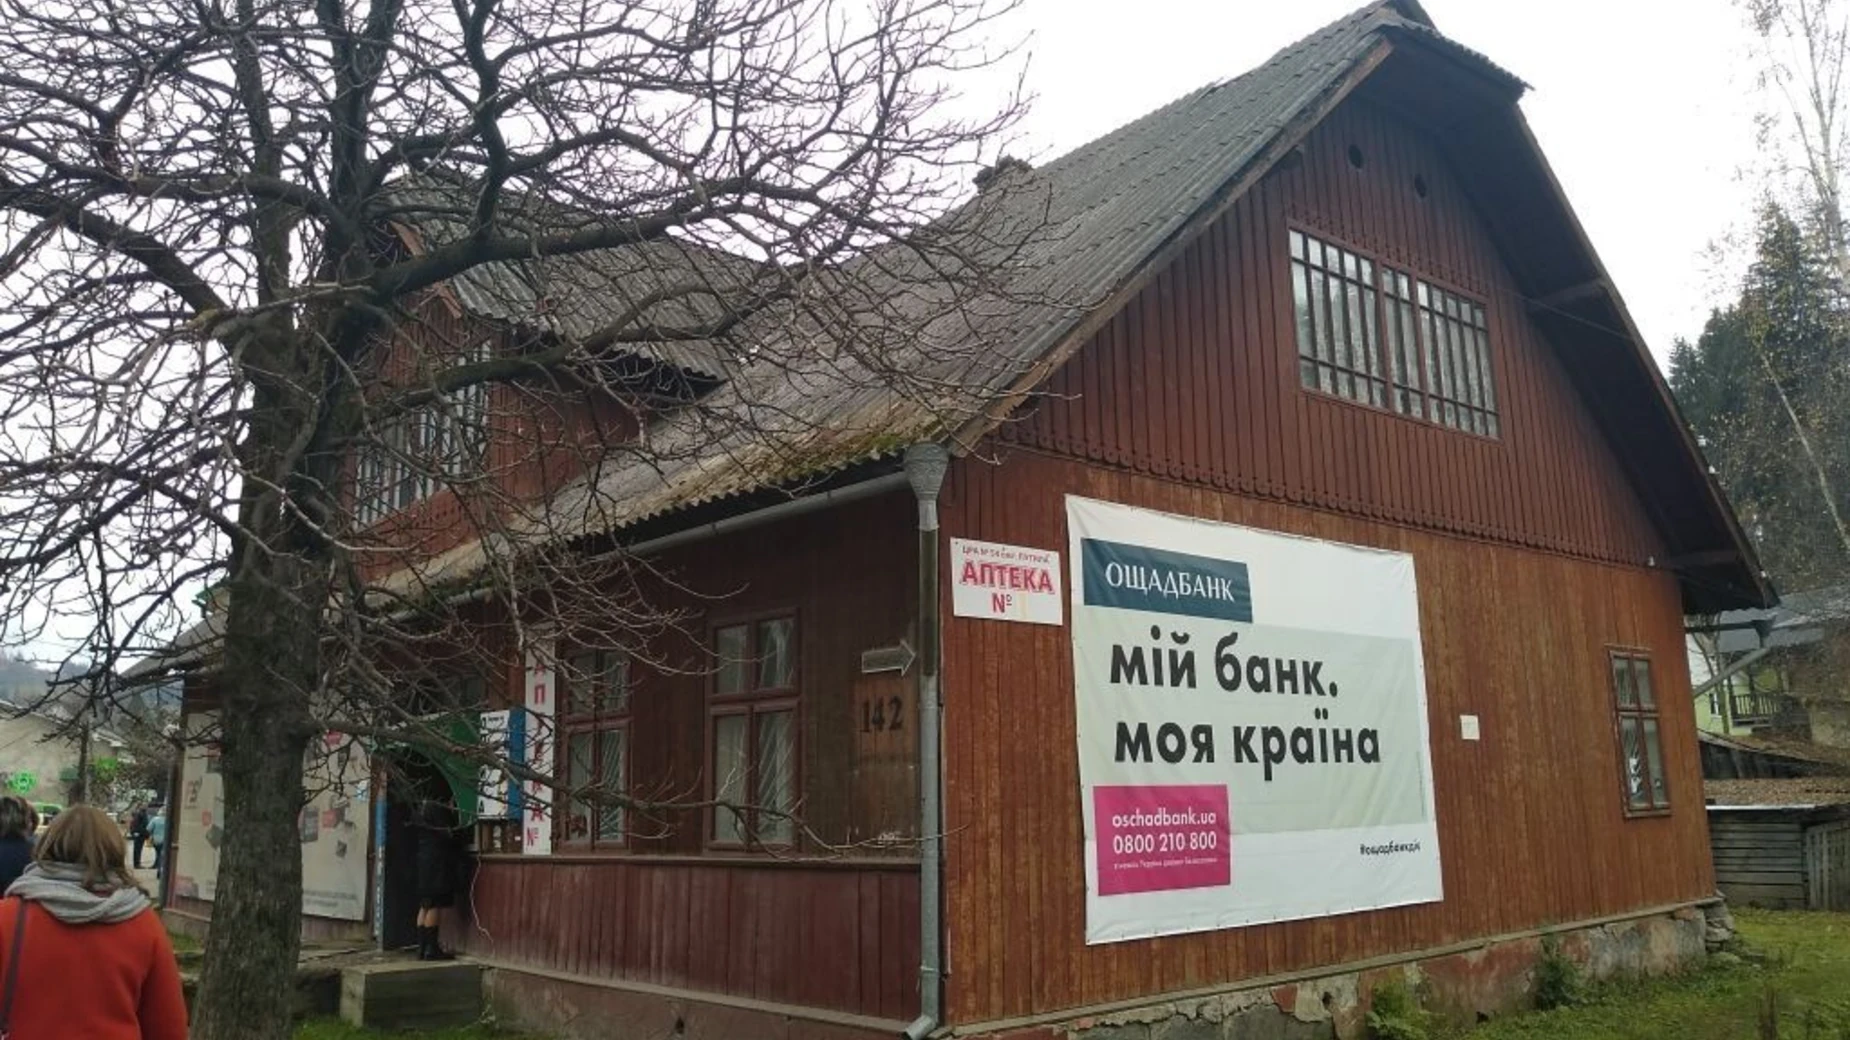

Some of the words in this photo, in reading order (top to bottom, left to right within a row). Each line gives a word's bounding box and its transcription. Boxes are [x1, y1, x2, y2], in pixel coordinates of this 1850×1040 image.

[962, 560, 1055, 594] АПТЕКА
[1105, 561, 1235, 602] ОЩАДБАНК
[1110, 624, 1197, 688] мій
[1215, 631, 1338, 698] банк.
[859, 695, 903, 733] 142
[1114, 721, 1215, 764] моя
[1232, 707, 1381, 782] країна
[1112, 806, 1217, 828] oschadbank.ua
[1113, 833, 1155, 854] 0800
[1159, 832, 1185, 852] 210
[1190, 830, 1217, 850] 800
